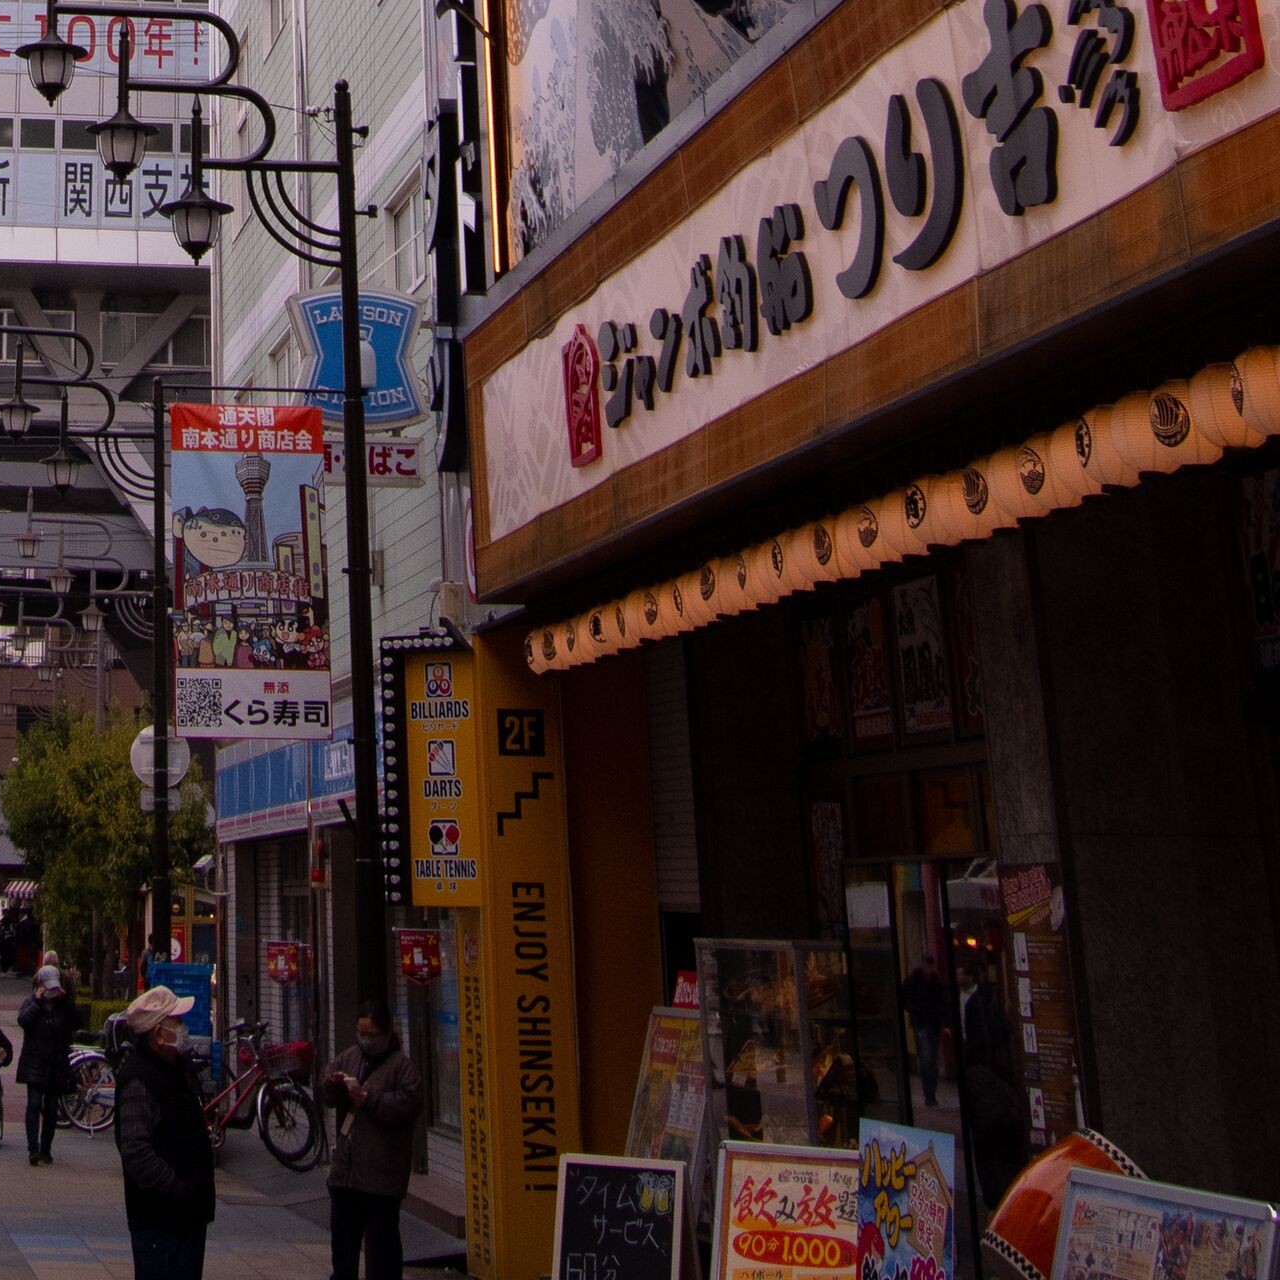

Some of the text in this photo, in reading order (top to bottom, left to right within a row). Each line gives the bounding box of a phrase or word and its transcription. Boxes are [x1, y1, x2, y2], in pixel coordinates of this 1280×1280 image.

[313, 305, 404, 327] LASON
[316, 385, 407, 406] STION
[218, 406, 275, 427] 通天閣
[181, 427, 313, 451] 南本通り商店会
[263, 681, 290, 694] 無添
[223, 699, 330, 727] くら寿司
[411, 700, 470, 720] BILLIARDS
[504, 715, 538, 753] 2F
[424, 780, 462, 798] DARTS
[415, 859, 477, 879] TABLE TENNIS
[512, 882, 558, 1192] ENJOY SHINSEKAI!
[576, 1175, 638, 1214] タイム
[733, 1176, 858, 1230] 飲み放題
[592, 1213, 660, 1250] サービス
